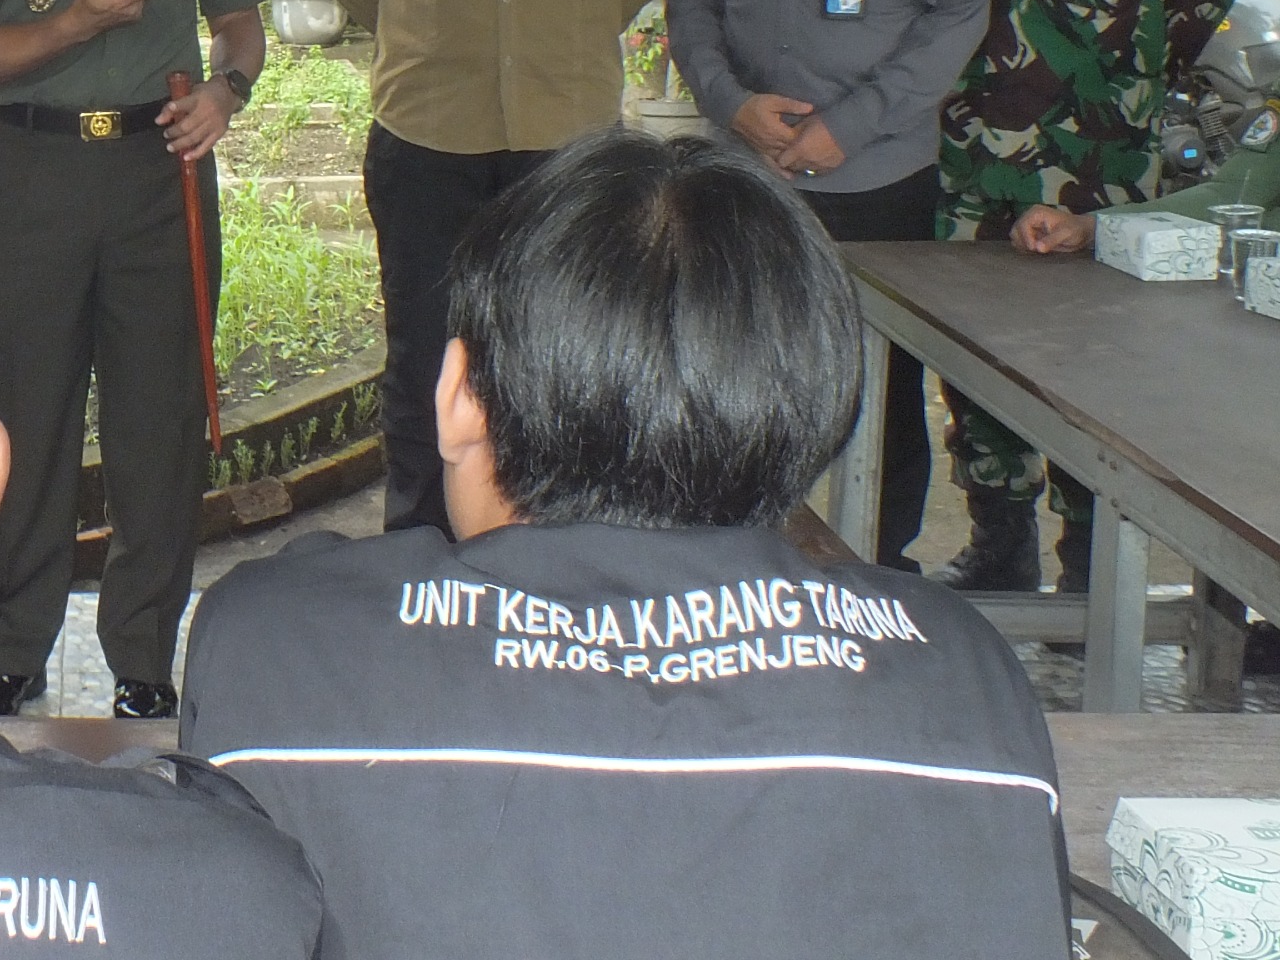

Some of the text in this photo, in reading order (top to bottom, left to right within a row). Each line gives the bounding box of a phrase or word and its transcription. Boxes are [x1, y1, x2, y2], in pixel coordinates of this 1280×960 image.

[399, 577, 928, 649] UNIT KERJA KARANG TARUNA
[494, 635, 867, 685] RW.06 P.GRENJENG
